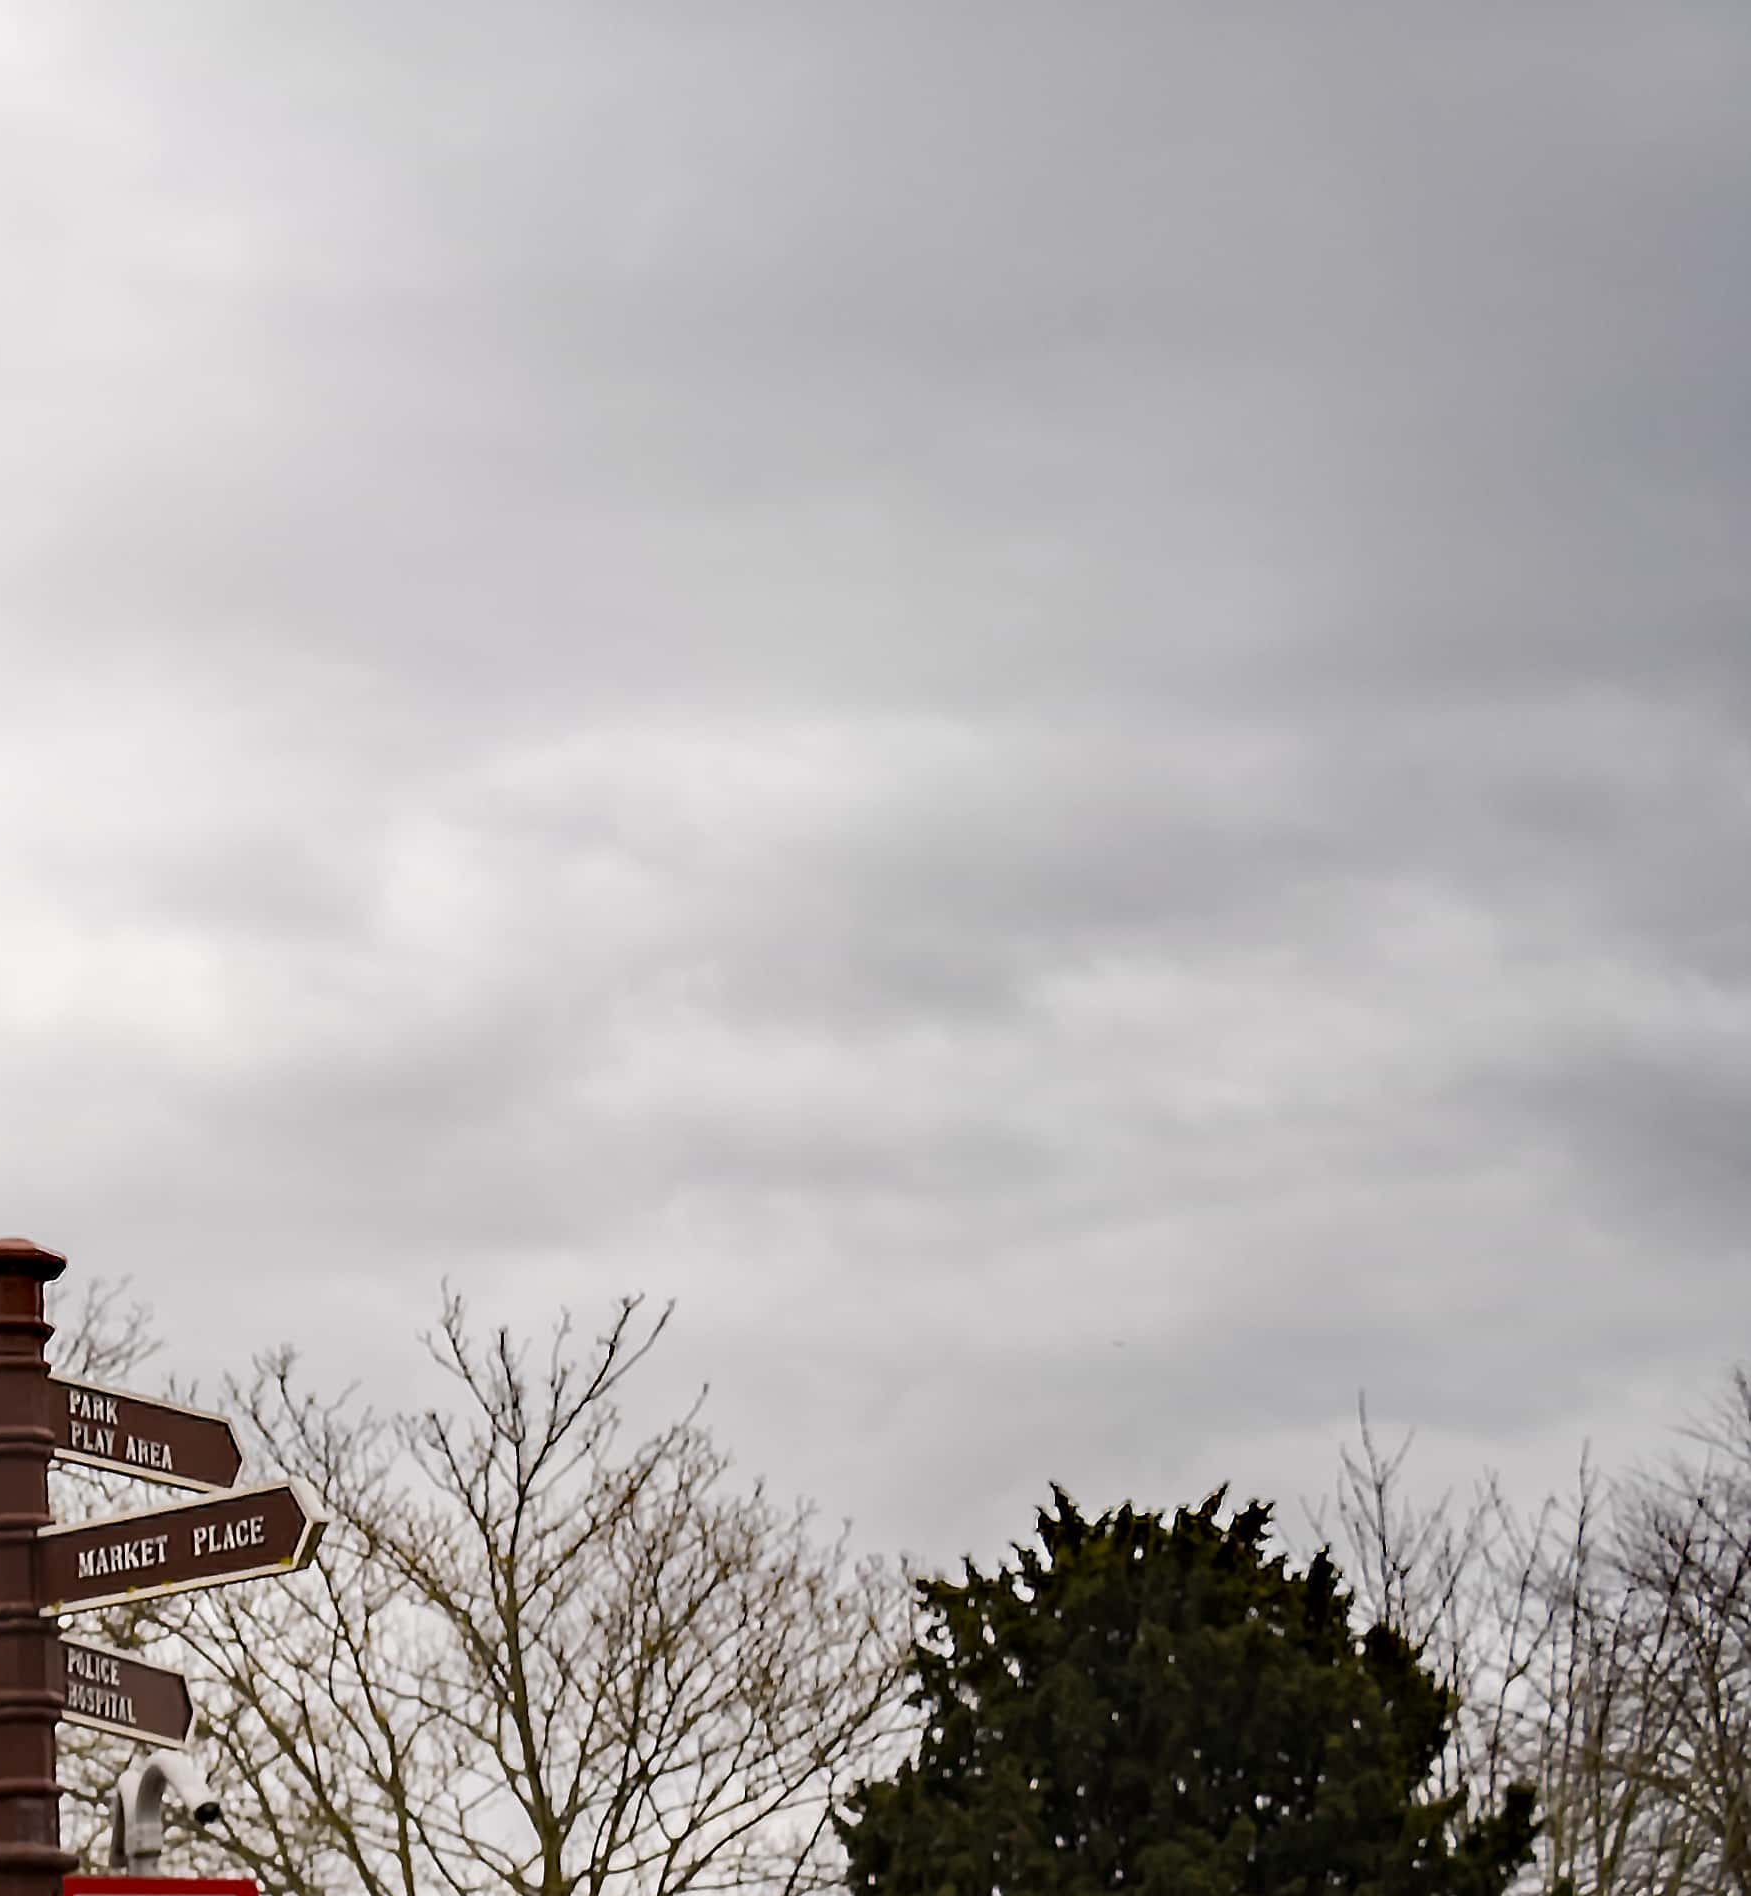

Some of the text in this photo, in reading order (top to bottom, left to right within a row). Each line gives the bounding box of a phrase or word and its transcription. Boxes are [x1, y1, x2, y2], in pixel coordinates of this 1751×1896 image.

[69, 1390, 118, 1425] PARK
[71, 1420, 173, 1470] PLAY AREA
[78, 1516, 265, 1579] MARKET PLACE
[66, 1646, 120, 1686] POLICE
[66, 1680, 136, 1724] HOSPITAL
